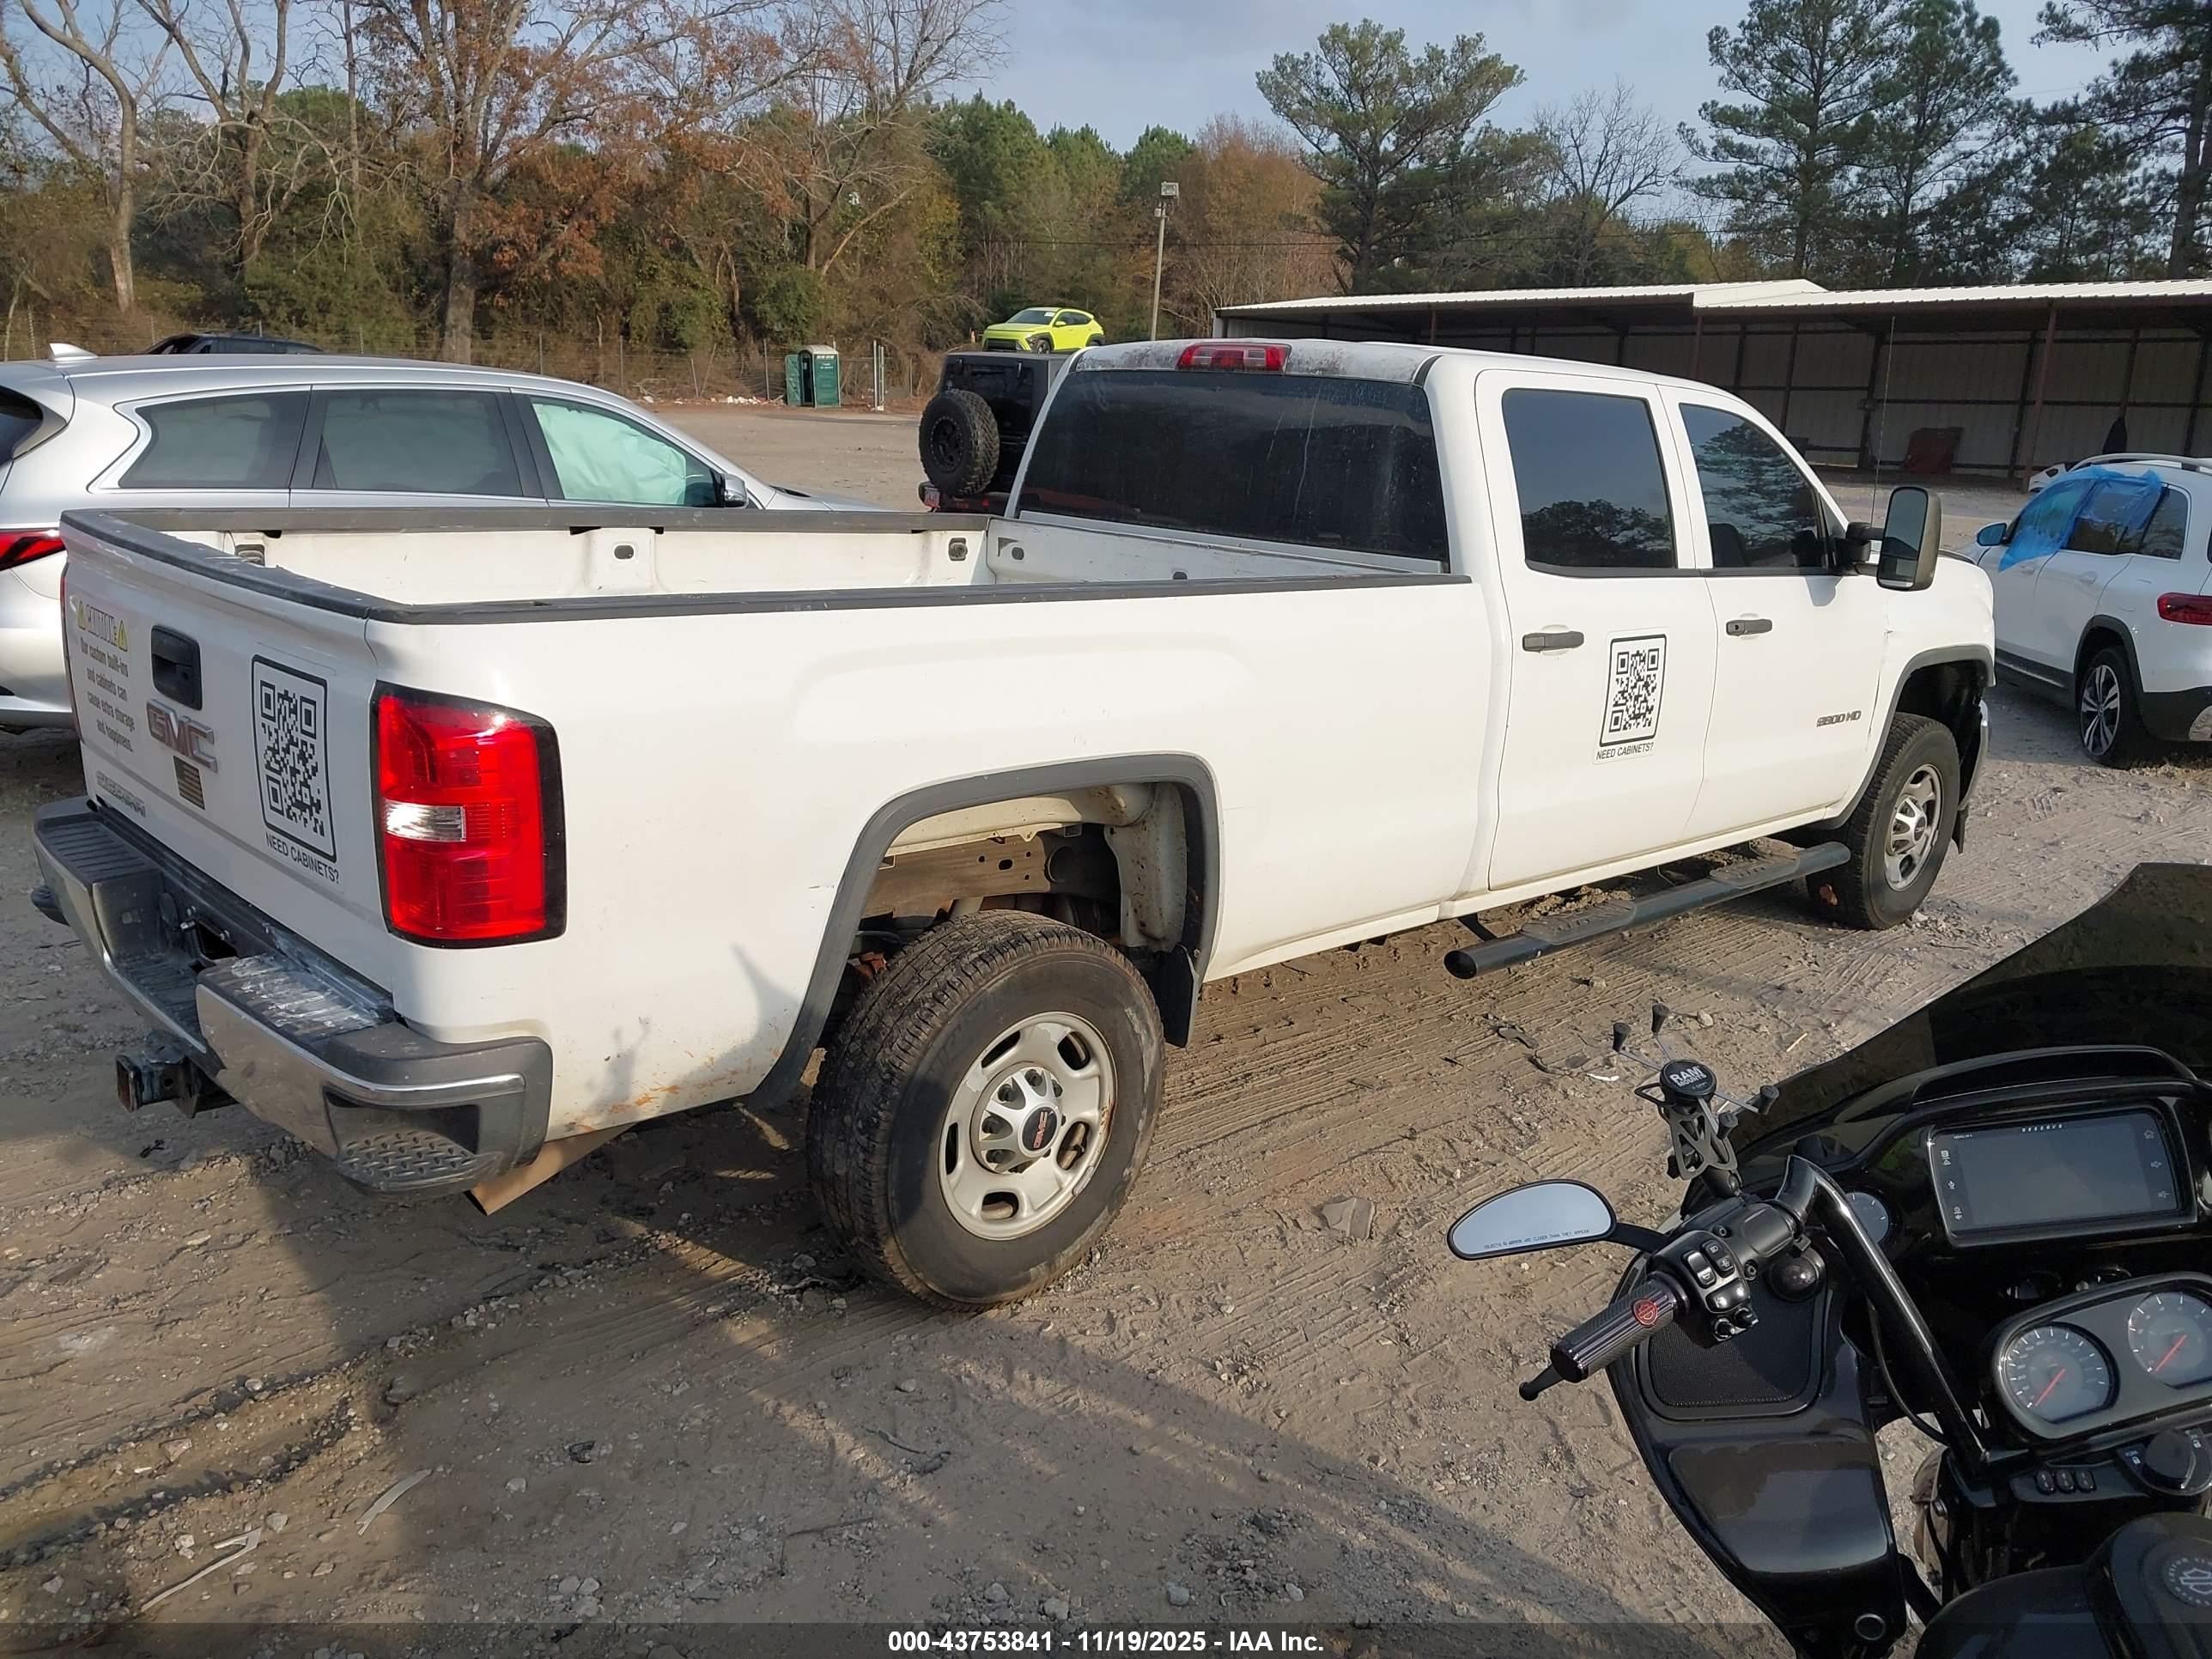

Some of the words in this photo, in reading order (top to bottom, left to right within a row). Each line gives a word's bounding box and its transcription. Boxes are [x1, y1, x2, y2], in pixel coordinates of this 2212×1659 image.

[146, 698, 219, 774] GMC
[1595, 748, 1616, 761] NEED
[1617, 741, 1655, 757] CABINETS?
[265, 831, 289, 857] NEED
[290, 846, 340, 884] CABINETS?
[1669, 1066, 1703, 1083] RAM
[1677, 1073, 1707, 1088] MOUNTS
[1033, 1111, 1048, 1149] GMC
